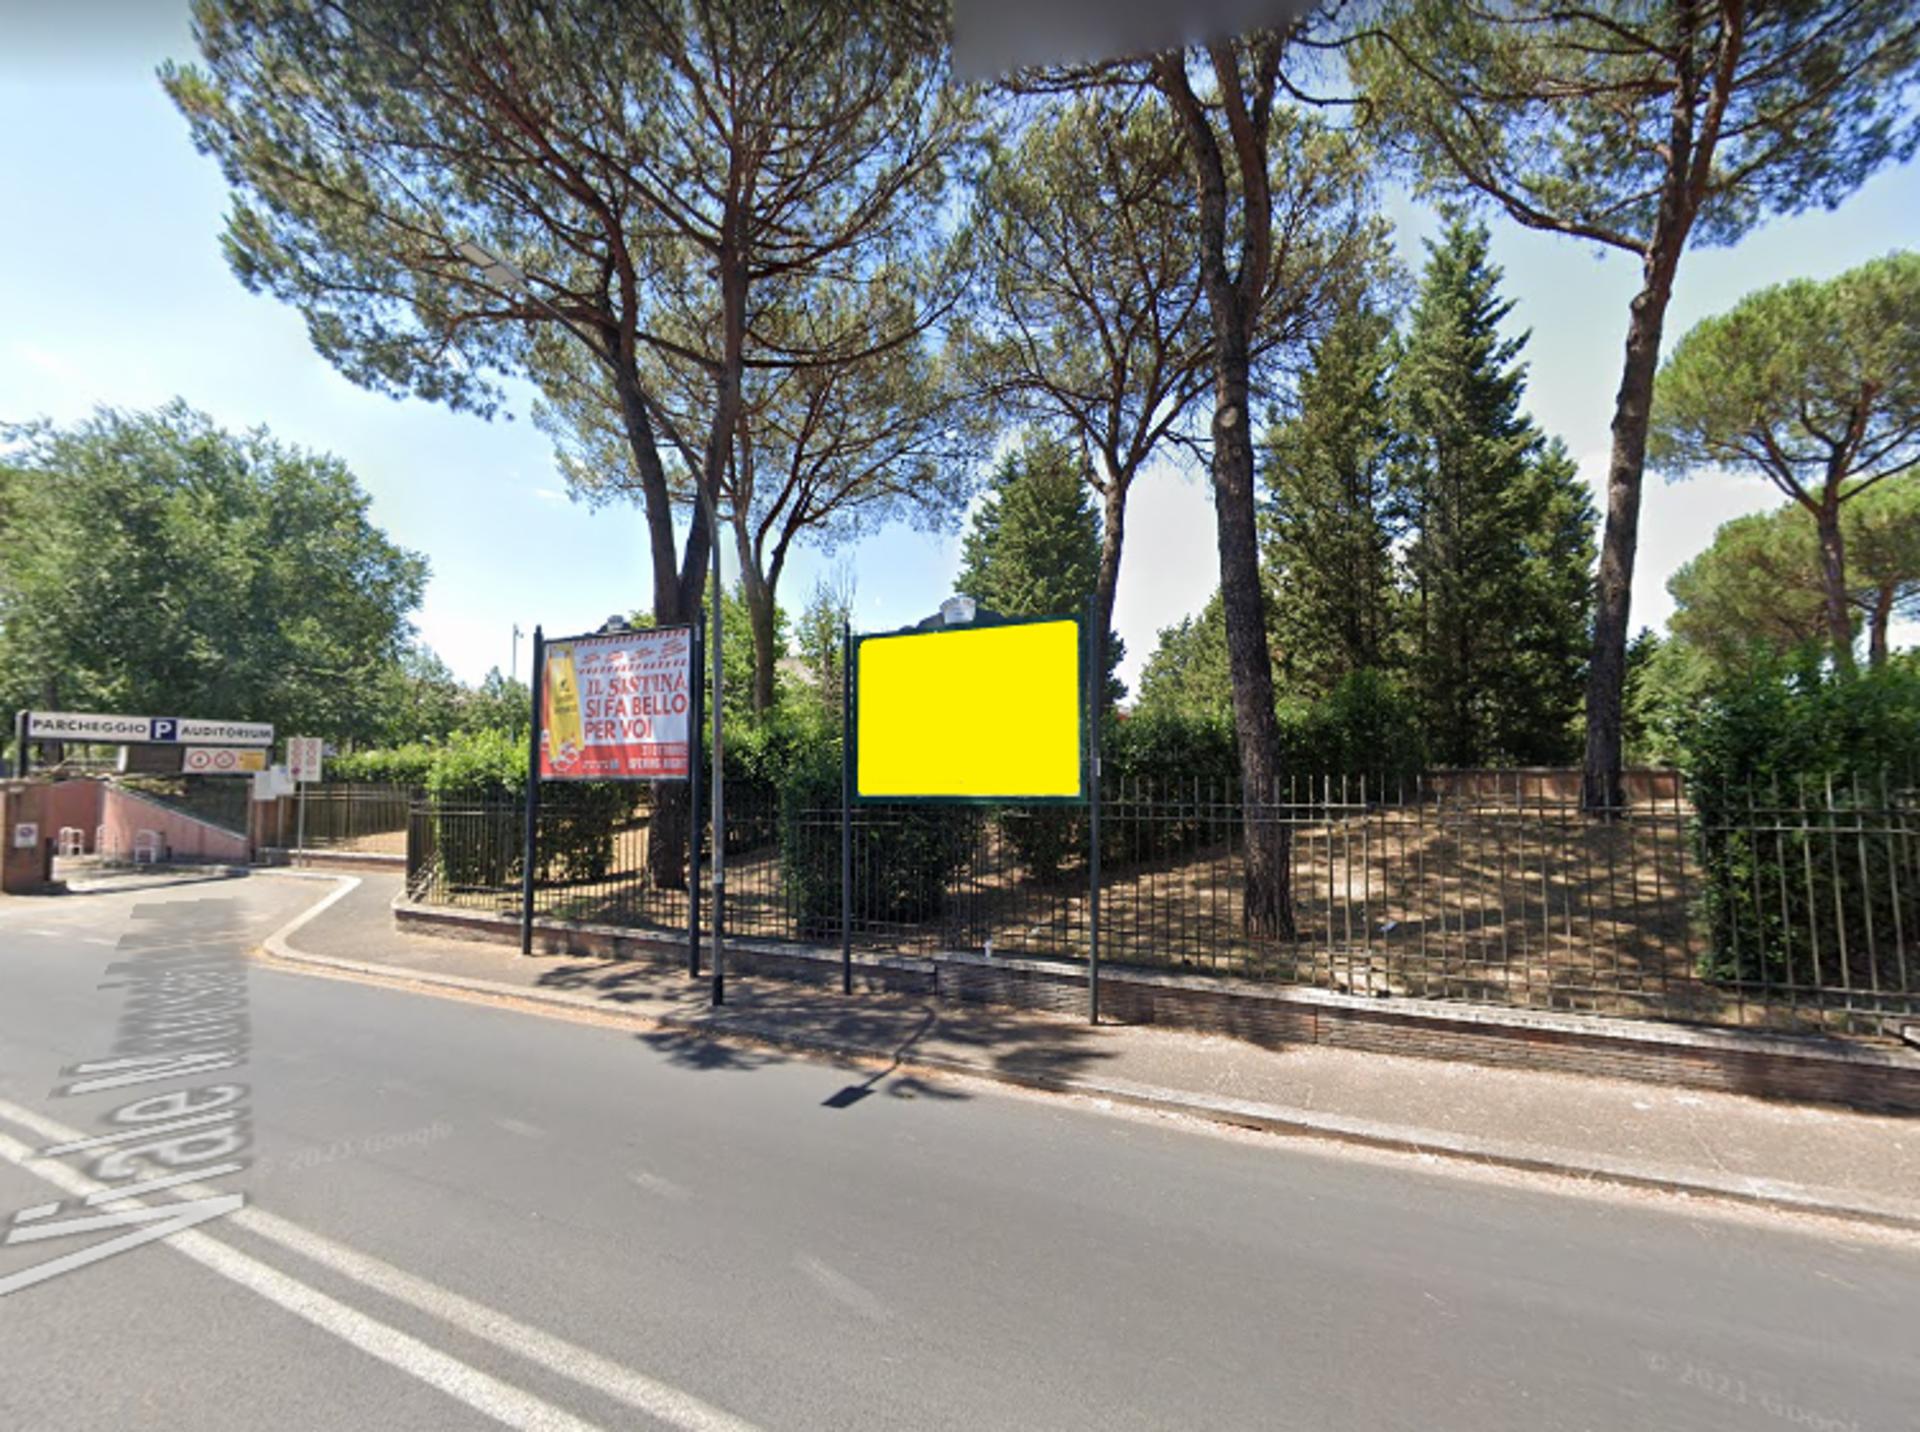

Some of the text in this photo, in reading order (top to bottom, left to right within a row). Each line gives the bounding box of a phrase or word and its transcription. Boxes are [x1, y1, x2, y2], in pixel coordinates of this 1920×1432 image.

[586, 679, 604, 697] IL
[585, 700, 600, 718] SI
[604, 697, 626, 718] FA
[632, 694, 688, 716] BELLO
[32, 718, 273, 740] PARCHEGGIO P AUDITORIUM
[584, 718, 652, 740] PER VOI
